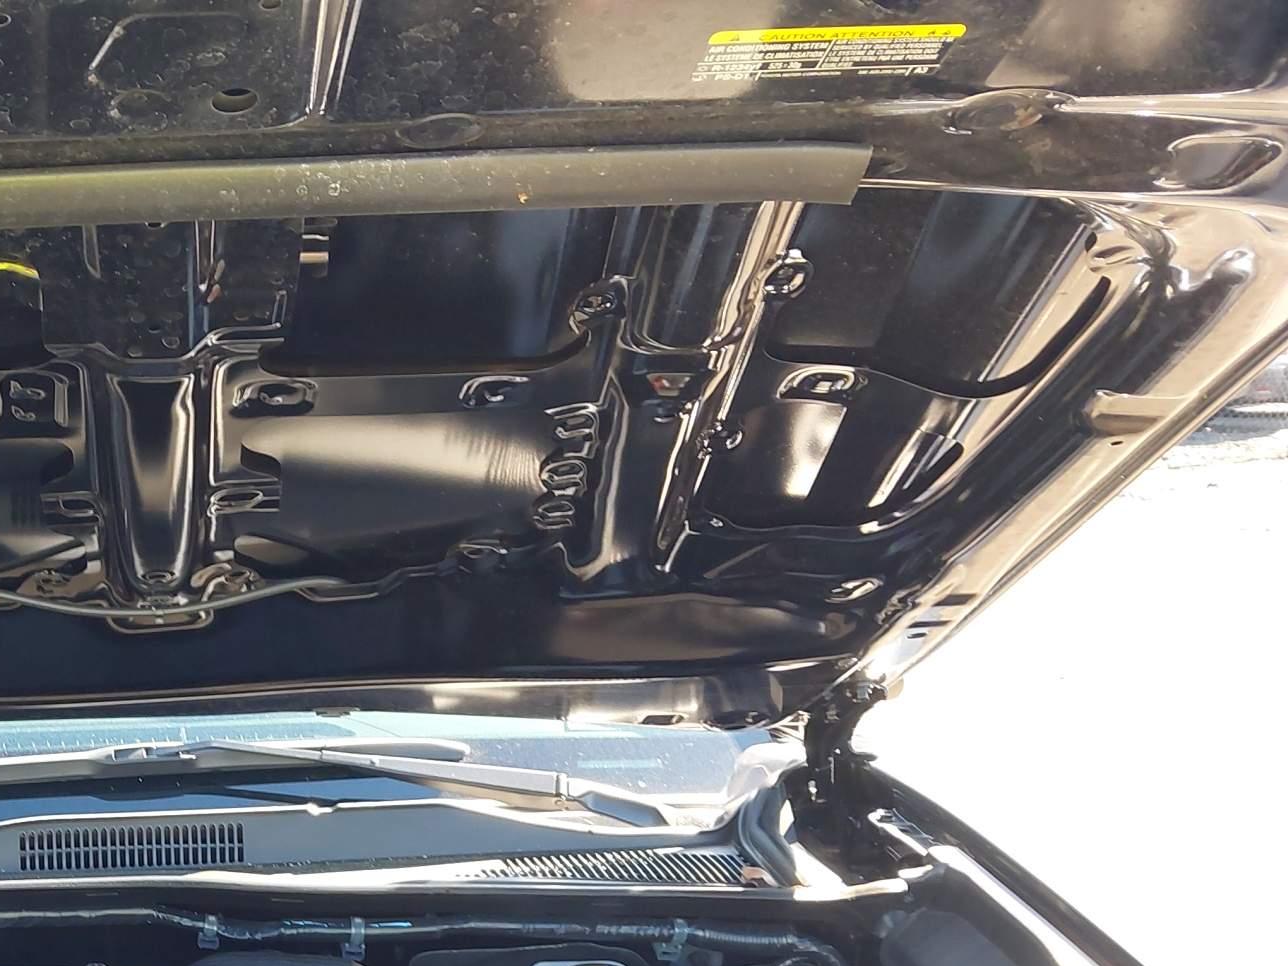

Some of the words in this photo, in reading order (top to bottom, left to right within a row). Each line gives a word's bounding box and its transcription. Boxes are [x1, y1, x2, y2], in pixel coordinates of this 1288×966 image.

[760, 32, 824, 42] CAUTION
[830, 29, 915, 39] ATTENTION
[791, 42, 829, 50] SYSTEM
